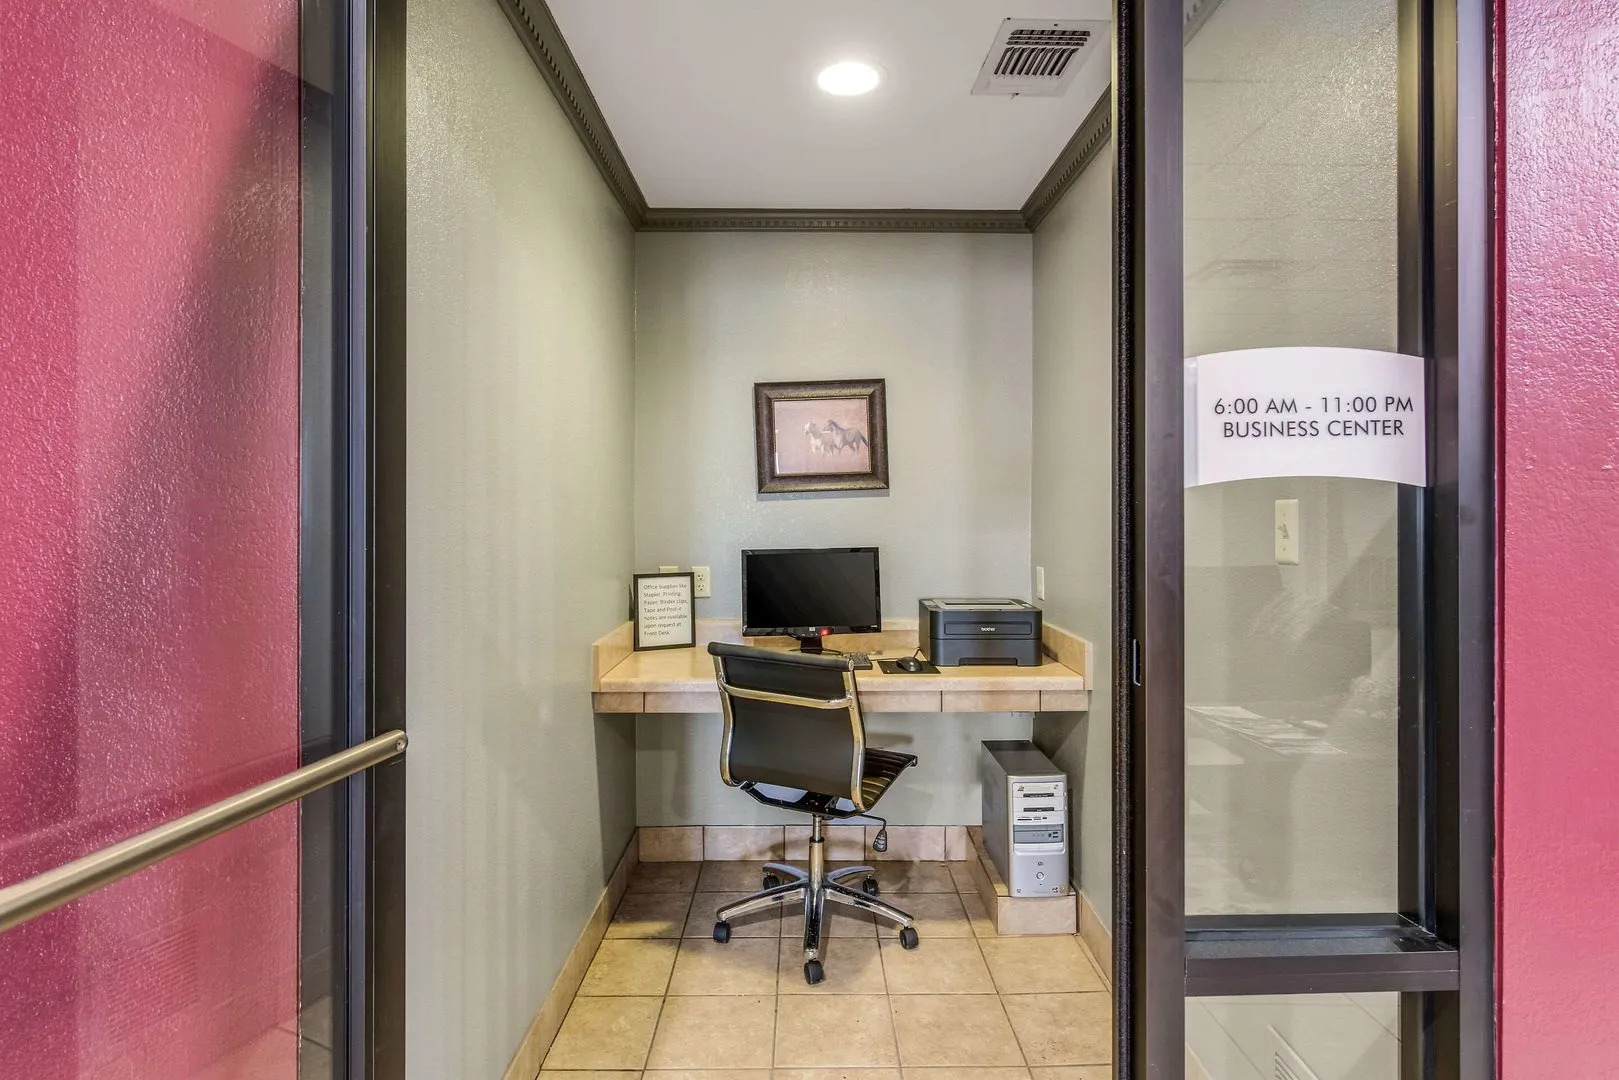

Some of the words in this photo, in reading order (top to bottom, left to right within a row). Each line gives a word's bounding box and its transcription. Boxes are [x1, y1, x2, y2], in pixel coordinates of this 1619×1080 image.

[1214, 397, 1258, 415] 6:00
[1265, 398, 1298, 414] AM
[1321, 396, 1377, 413] 11:00
[1385, 396, 1414, 412] PM
[1223, 420, 1320, 438] BUSINESS
[1327, 419, 1405, 436] CENTER
